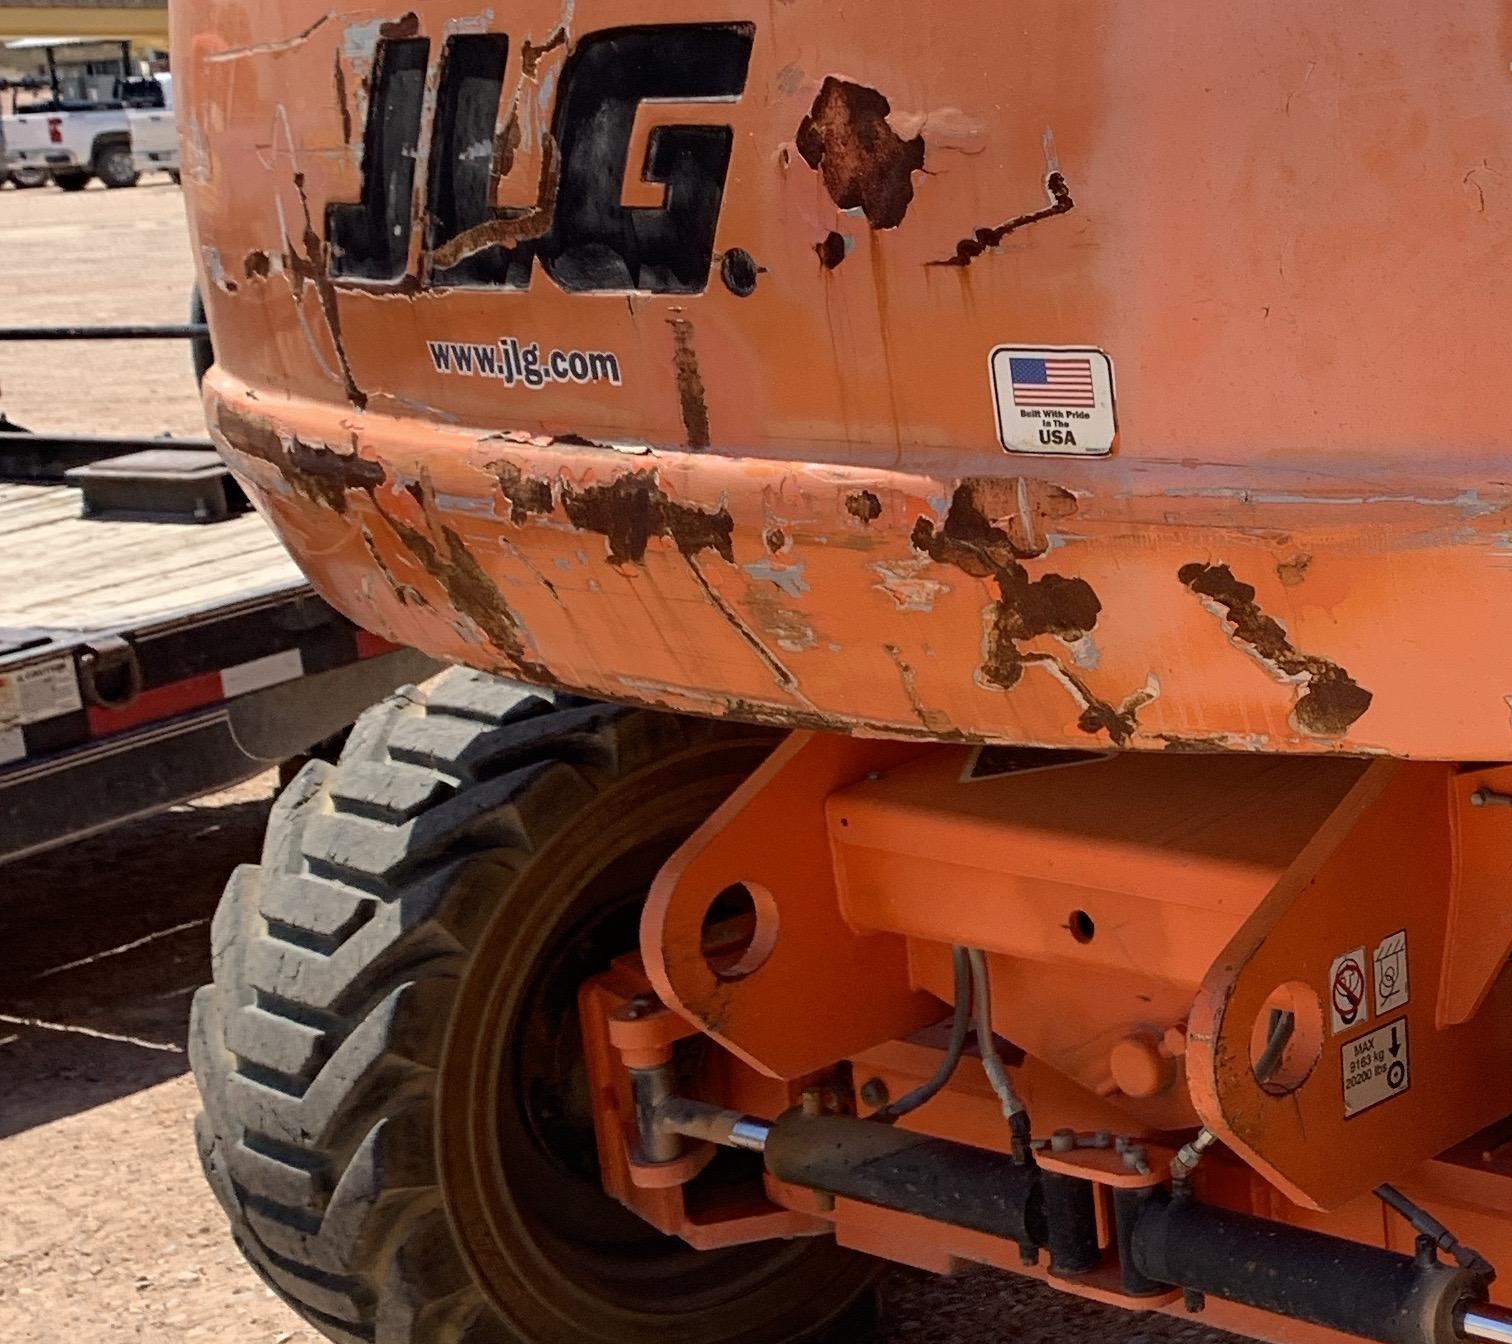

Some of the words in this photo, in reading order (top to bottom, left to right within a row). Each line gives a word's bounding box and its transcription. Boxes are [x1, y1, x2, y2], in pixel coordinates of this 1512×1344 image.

[325, 20, 757, 296] JLG
[427, 337, 622, 389] www.jlg.com
[1020, 409, 1042, 418] Built
[1043, 410, 1064, 418] With
[1066, 410, 1090, 419] Pride
[1053, 420, 1069, 428] The
[1039, 429, 1077, 446] USA
[1353, 1038, 1375, 1056] MAX
[1373, 1050, 1385, 1062] kg
[1345, 1069, 1372, 1089] 20200
[1375, 1063, 1387, 1076] lbs
